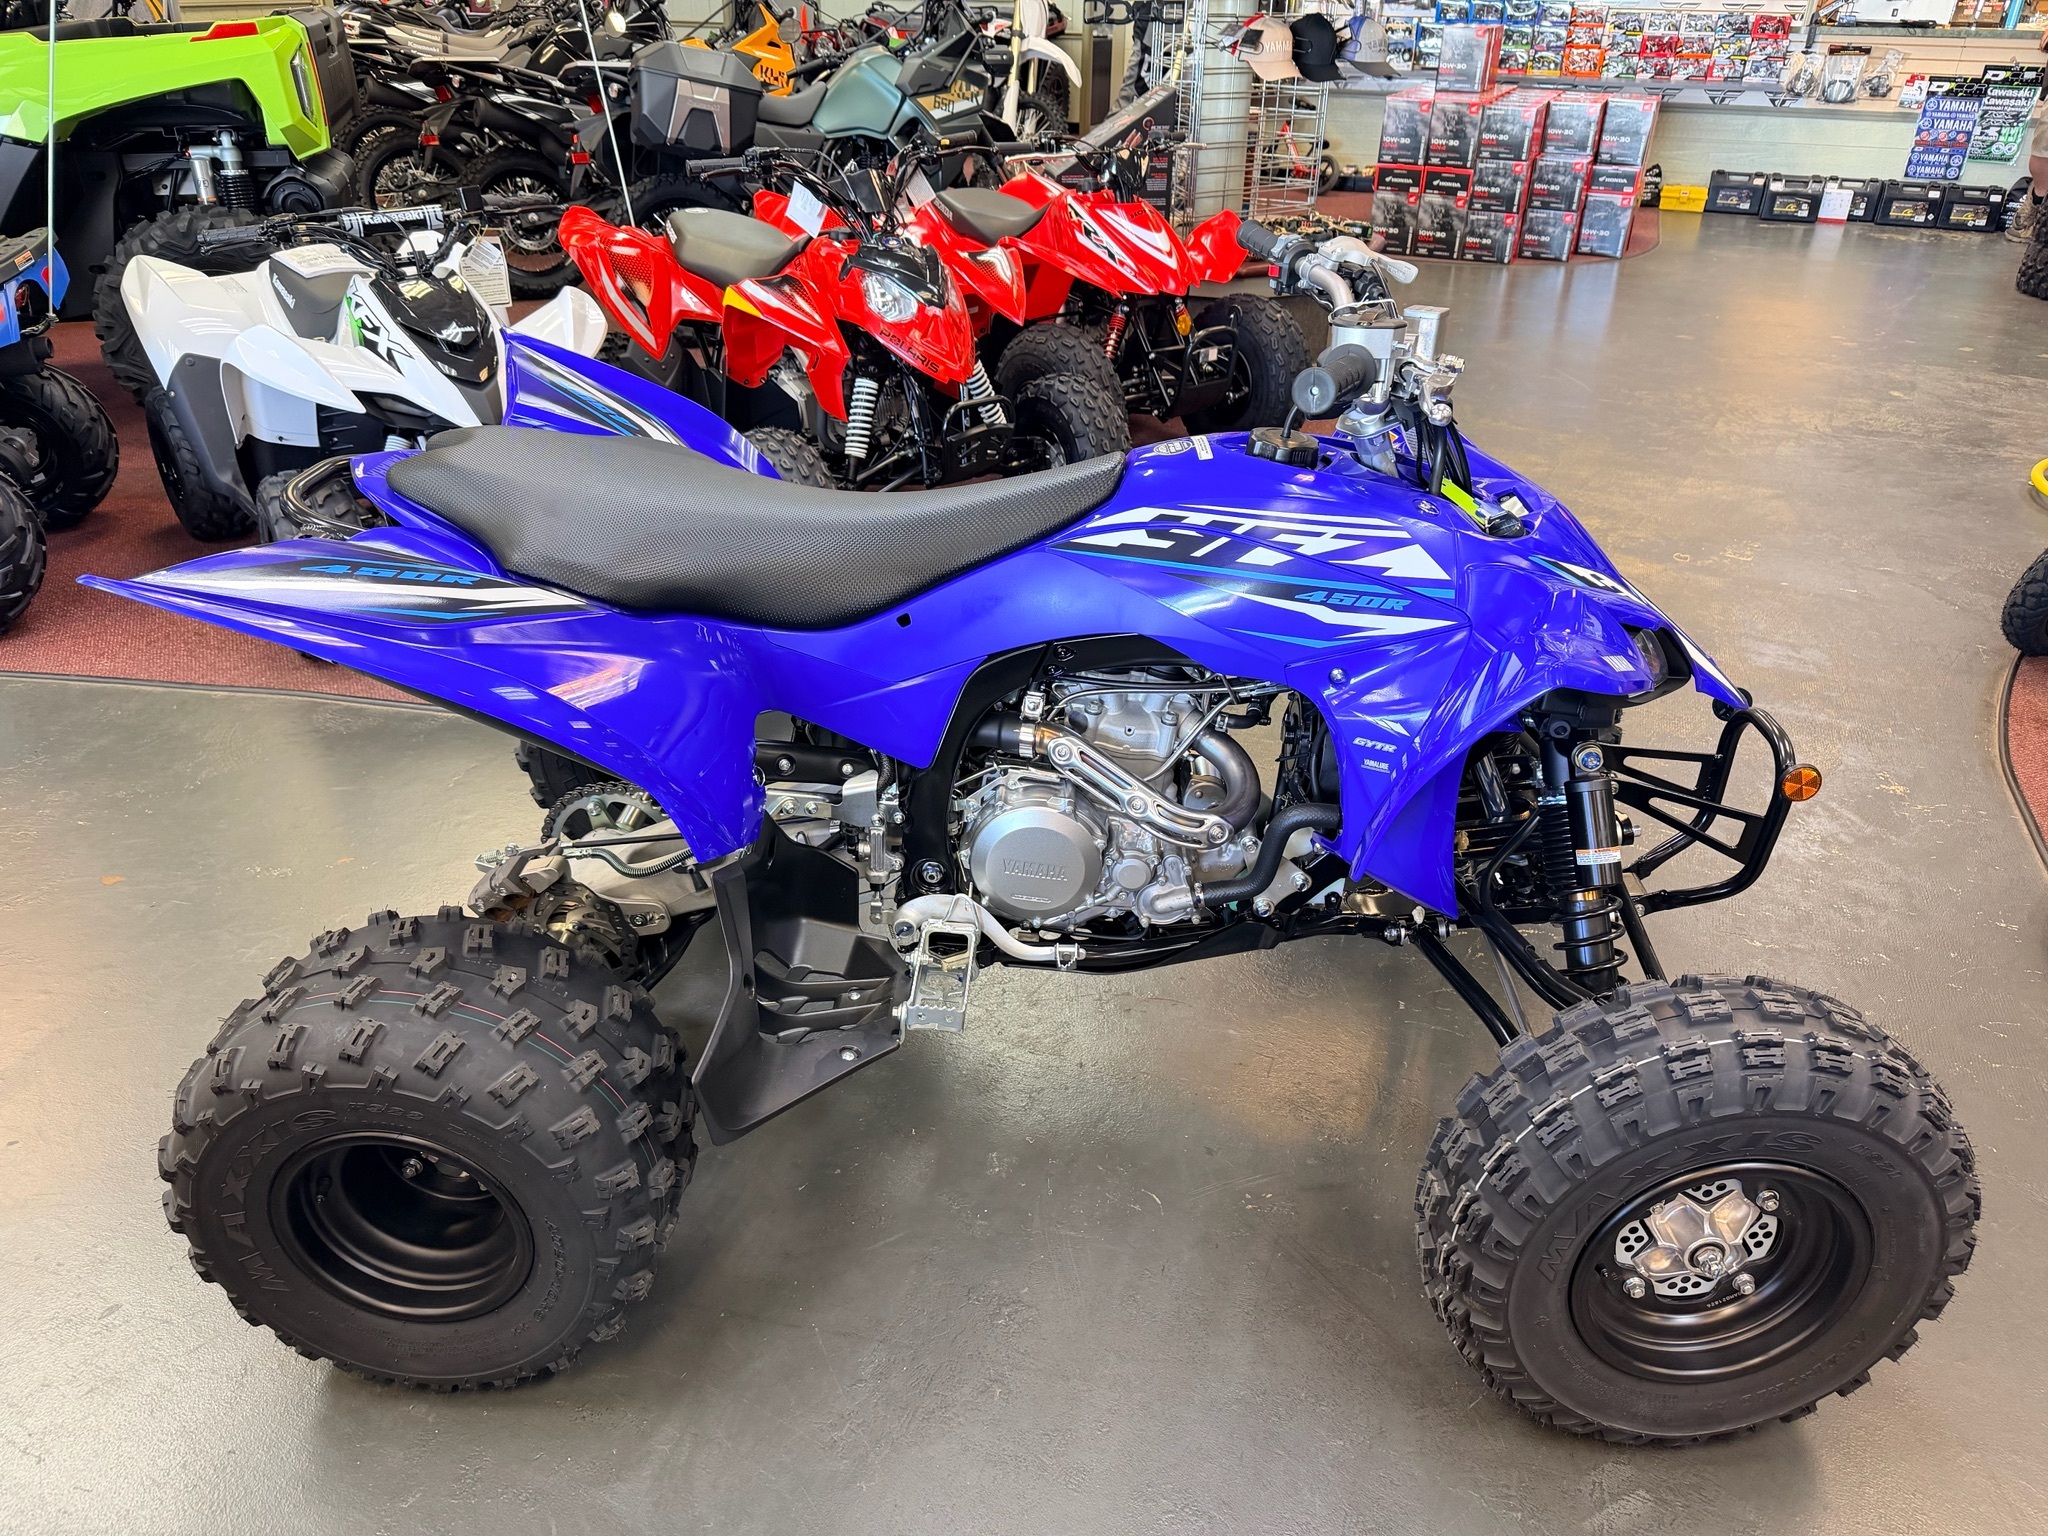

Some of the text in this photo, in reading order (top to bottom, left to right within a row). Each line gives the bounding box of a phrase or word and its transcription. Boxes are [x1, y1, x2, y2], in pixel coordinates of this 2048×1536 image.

[412, 29, 440, 41] Kawasaki
[408, 41, 439, 53] Kawasaki
[1987, 86, 2035, 98] Kawasaki
[933, 95, 955, 114] 650
[1938, 100, 1980, 112] YAMAHA
[1982, 97, 2031, 106] Kawasaki
[1933, 119, 1974, 131] YAMAHA
[1382, 135, 1411, 144] 10W-30
[1431, 138, 1460, 147] 10W-30
[1602, 135, 1631, 143] 10W-30
[1918, 153, 1949, 163] YAMAHA
[1915, 166, 1945, 176] YAMAHA
[1391, 176, 1413, 184] HONDA
[1474, 185, 1501, 193] 10W-30
[1533, 183, 1560, 191] 10W-30
[364, 210, 426, 226] Kawasaki
[1418, 230, 1447, 239] 10W-30
[1524, 234, 1550, 242] 10W-30
[1582, 228, 1610, 236] 10W-30
[1466, 236, 1492, 245] 10W-30
[272, 272, 297, 310] Kawasaki
[879, 328, 940, 374] POLARIS
[300, 564, 481, 586] 450R
[1294, 589, 1413, 612] 450R
[1352, 736, 1398, 754] GYTR
[1003, 858, 1068, 882] YAMAHA
[219, 1109, 340, 1292] MAXXIS
[1537, 1130, 1824, 1284] MAXXIS
